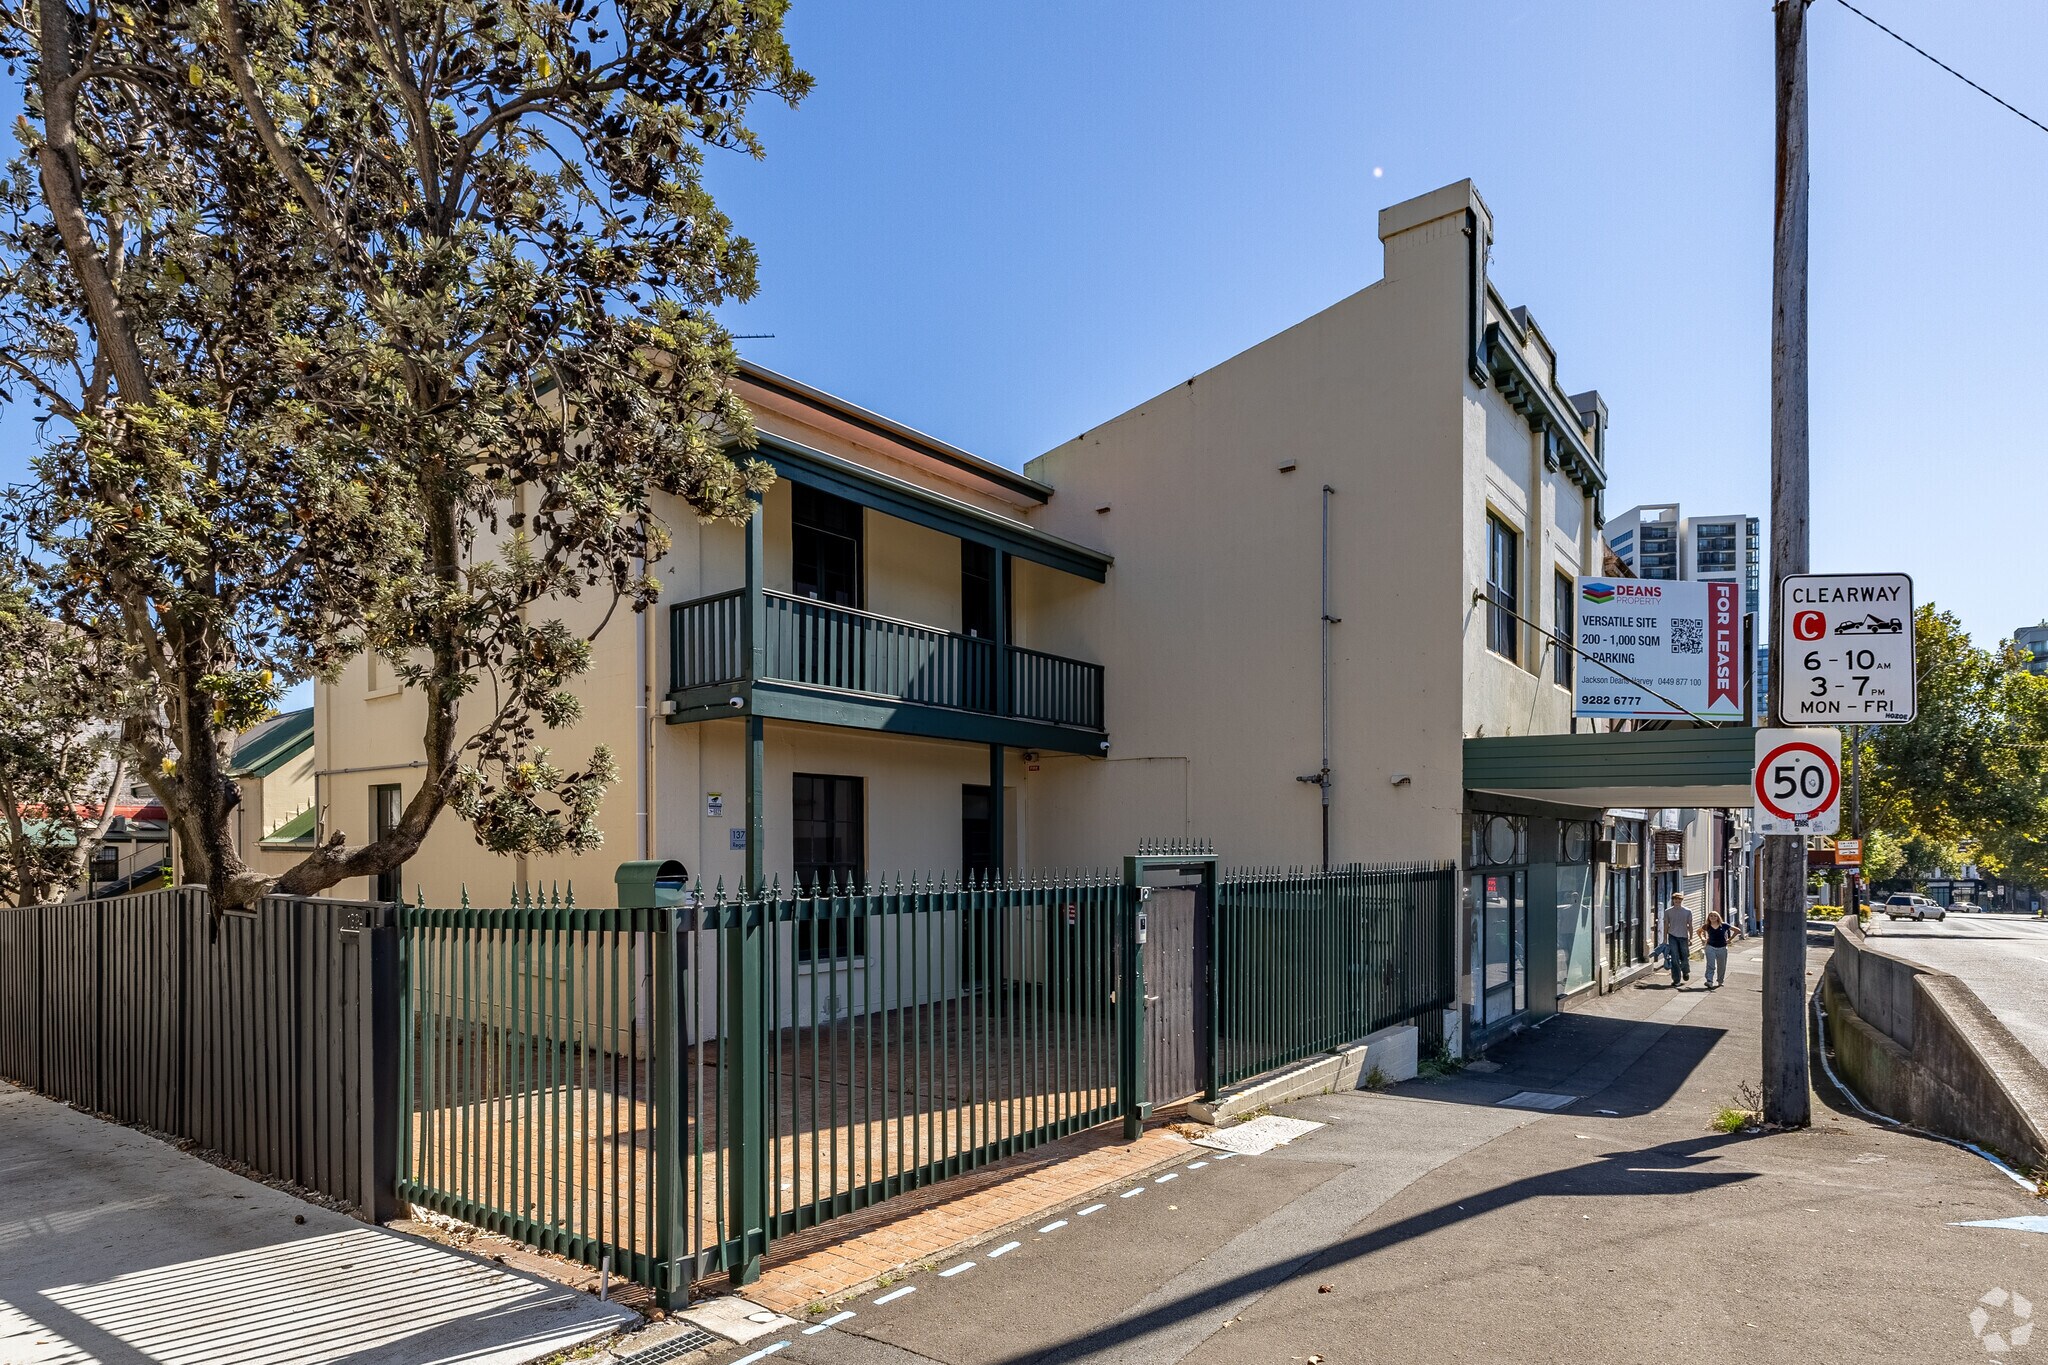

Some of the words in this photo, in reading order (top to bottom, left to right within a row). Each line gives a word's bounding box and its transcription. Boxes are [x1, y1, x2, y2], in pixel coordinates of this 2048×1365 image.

[1617, 585, 1662, 597] DEANS
[1793, 586, 1901, 603] CLEARWAY
[1617, 597, 1662, 605] PROPERTY
[1716, 586, 1730, 624] FOR
[1582, 616, 1634, 628] VERSATILE
[1636, 617, 1657, 628] SITE
[1582, 634, 1600, 645] 200
[1611, 635, 1636, 647] 1,000
[1638, 635, 1660, 646] SQM
[1593, 652, 1635, 664] PARKING
[1716, 630, 1730, 690] LEASE
[1804, 651, 1821, 671] 6
[1845, 650, 1875, 670] 10
[1582, 676, 1608, 684] Jackson
[1690, 678, 1701, 686] 100
[1810, 676, 1827, 697] 3
[1852, 676, 1870, 696] 7
[1582, 696, 1610, 705] 9282
[1613, 696, 1641, 705] 6777
[1801, 701, 1840, 714] MON
[1864, 700, 1894, 713] FRI
[1774, 765, 1824, 799] 50
[732, 830, 746, 839] 137
